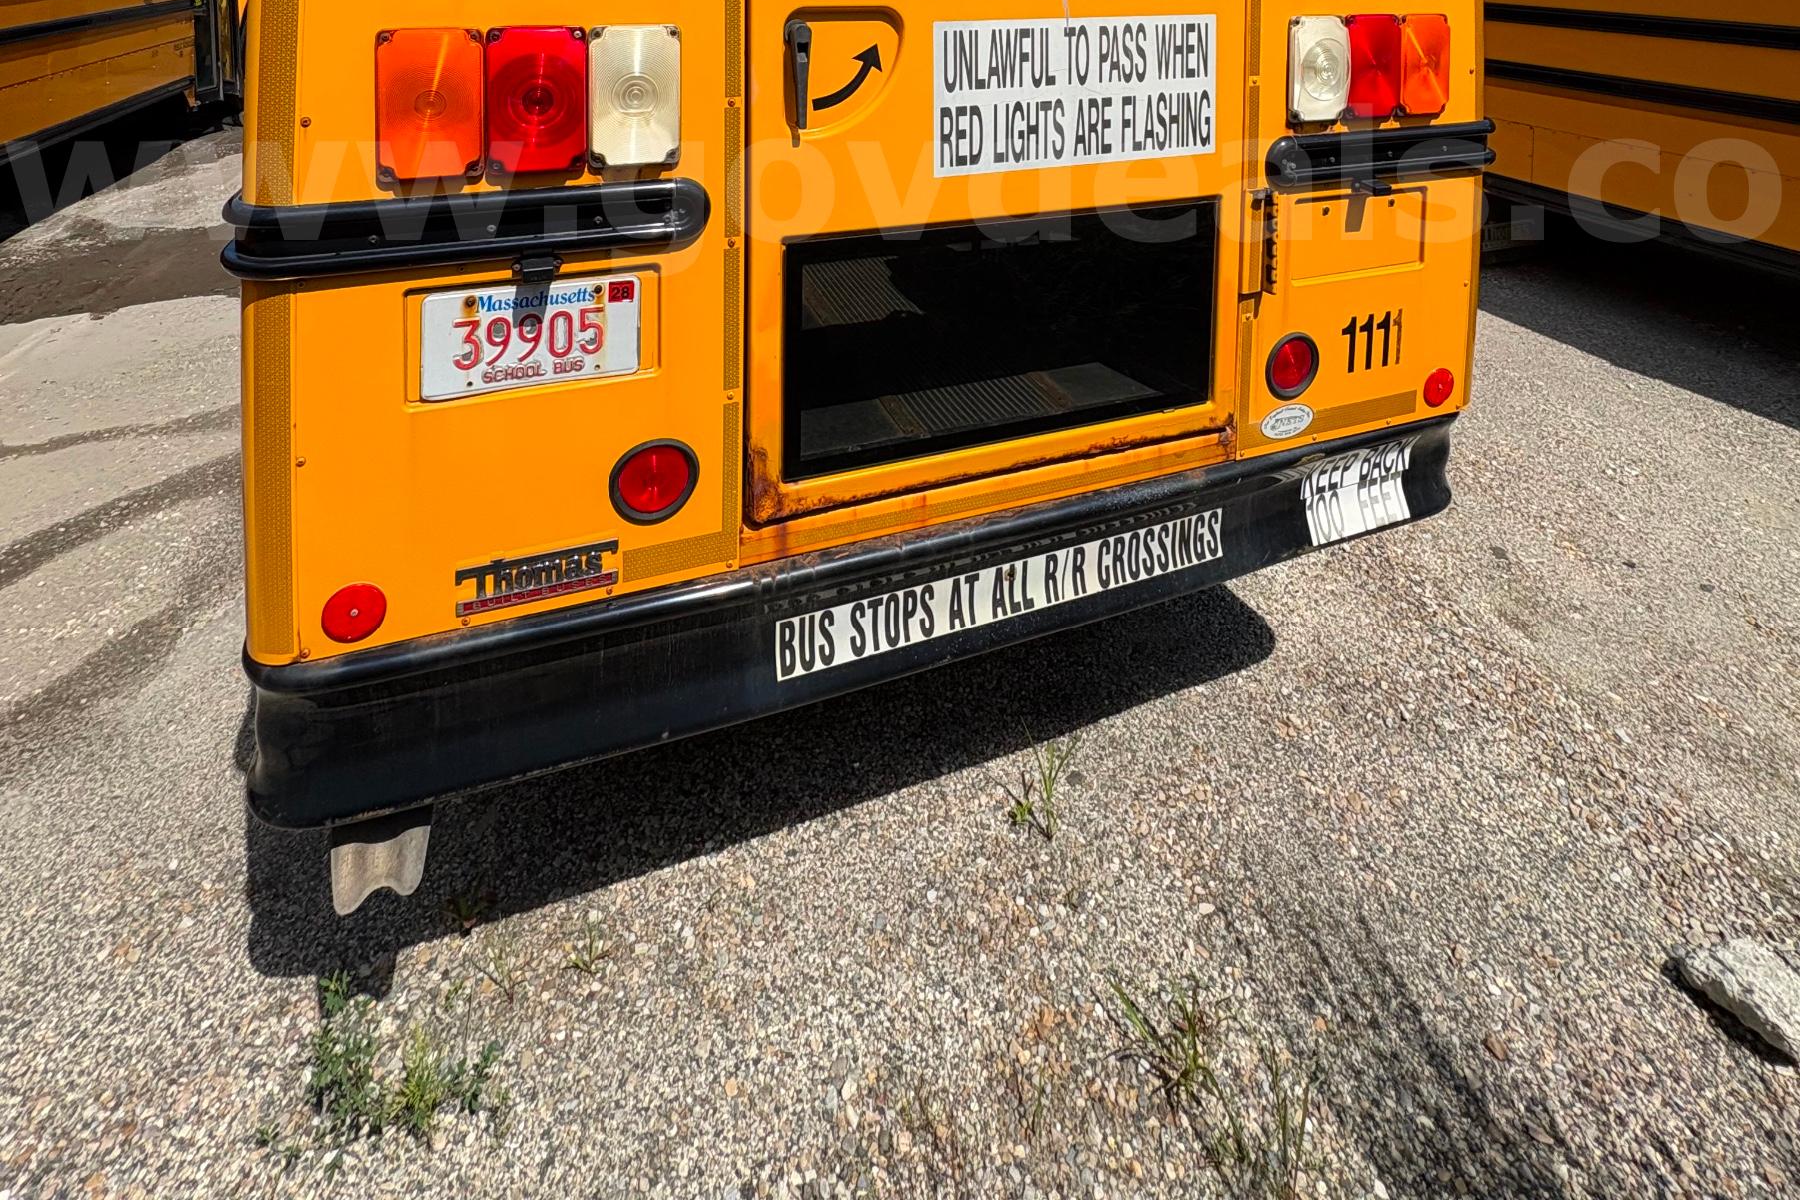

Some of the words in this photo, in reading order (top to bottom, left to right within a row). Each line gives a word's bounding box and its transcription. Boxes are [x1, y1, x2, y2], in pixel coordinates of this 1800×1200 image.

[943, 27, 1056, 93] UNLAWFUL
[1063, 24, 1090, 86] TO
[1098, 22, 1147, 83] PASS
[1155, 22, 1209, 80] WHEN
[940, 105, 983, 168] RED
[993, 98, 1065, 163] LIGHTS
[1073, 97, 1112, 156] ARE
[1121, 89, 1211, 153] FLASHING
[476, 287, 596, 313] Massachusetts
[611, 286, 630, 300] 28
[452, 304, 605, 371] 39905
[482, 361, 546, 384] SCHOOL
[553, 356, 585, 374] BUS
[1302, 452, 1360, 498] KEEP
[1359, 436, 1420, 480] BACK
[1307, 489, 1344, 543] 100
[455, 538, 619, 600] Thomas
[473, 592, 530, 611] BUILT
[541, 573, 607, 596] BUSES
[779, 609, 836, 678] BUS
[849, 583, 936, 658] STOPS
[948, 573, 977, 632] AT
[991, 559, 1035, 620] ALL
[1044, 546, 1087, 605] R/R
[1096, 509, 1222, 590] CROSSINGS
